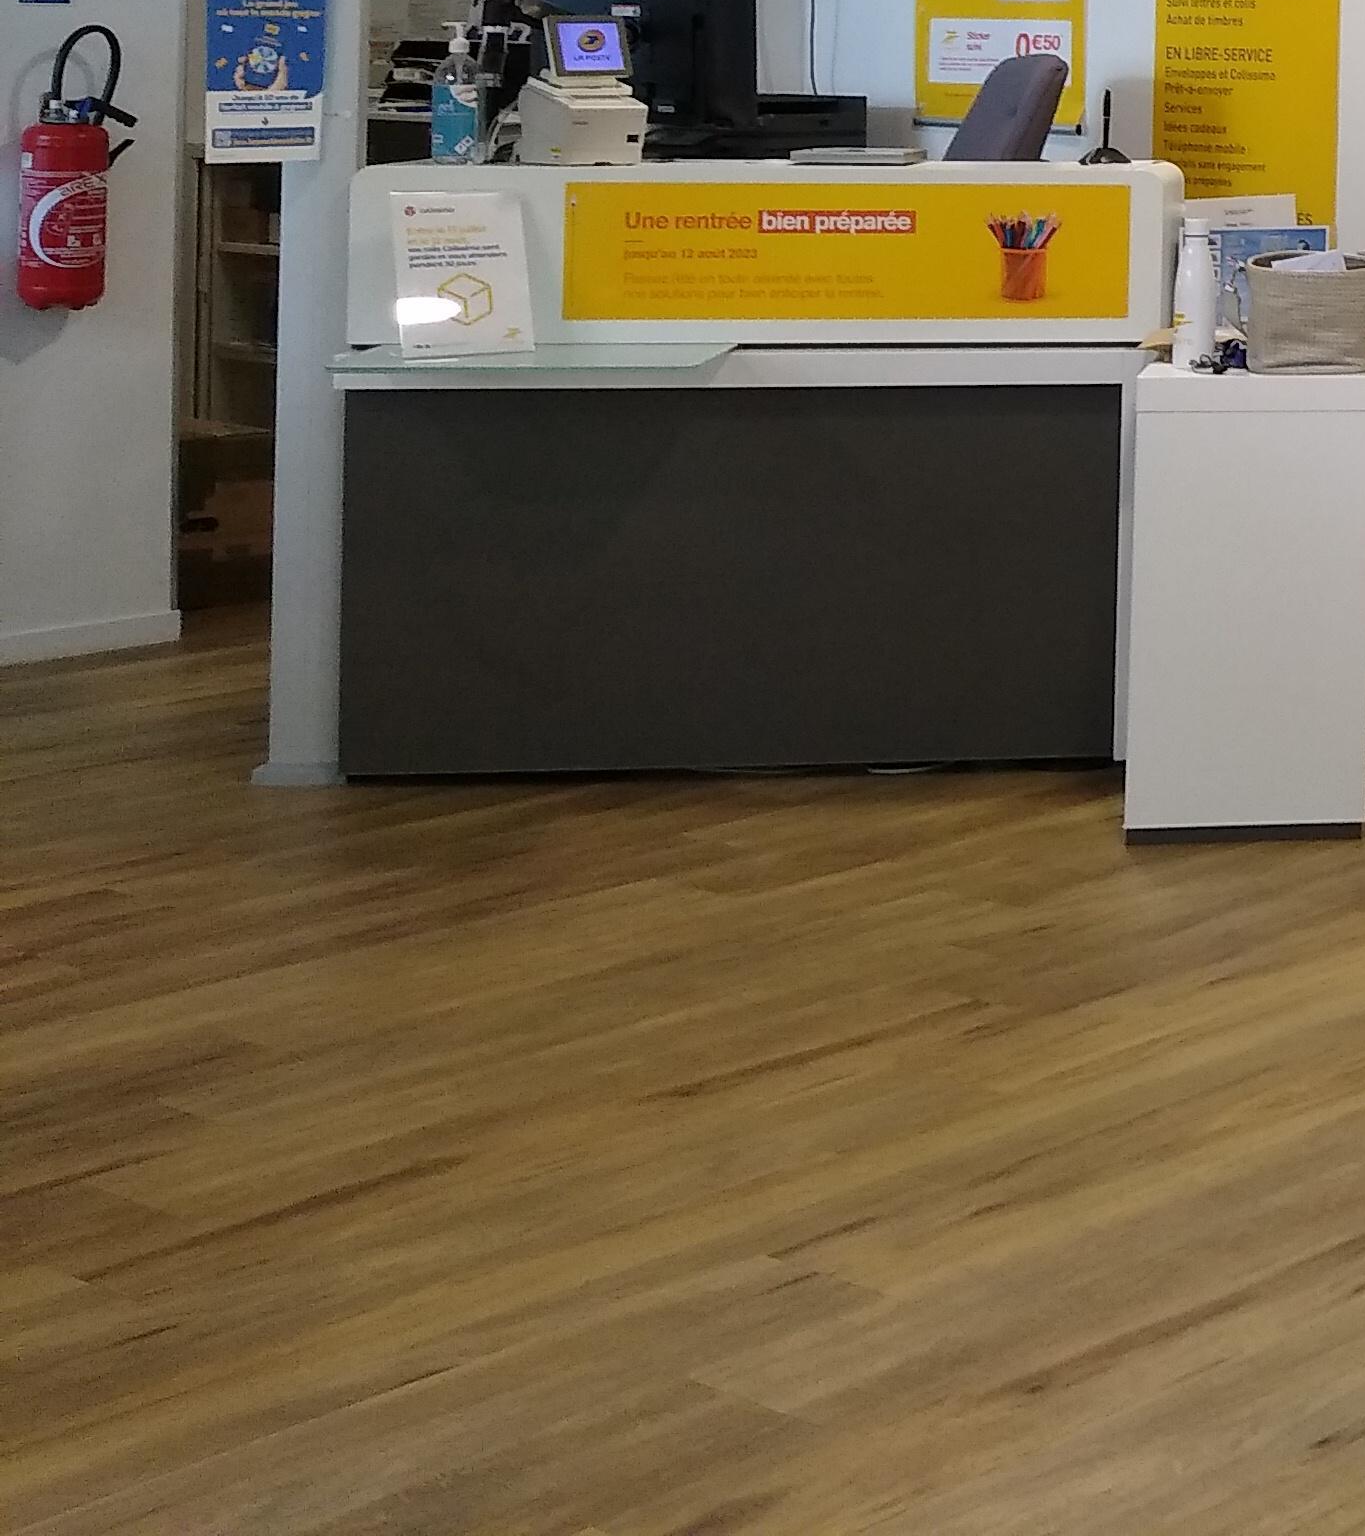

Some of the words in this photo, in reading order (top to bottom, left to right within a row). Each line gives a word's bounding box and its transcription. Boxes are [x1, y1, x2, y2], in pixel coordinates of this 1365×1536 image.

[1166, 14, 1192, 26] Achat
[1207, 14, 1244, 27] timbres
[1166, 47, 1181, 60] EN
[1185, 47, 1273, 63] LIBRE-SERVICE
[625, 211, 669, 230] Une
[675, 210, 752, 230] rentrée
[762, 211, 810, 231] bien
[814, 209, 912, 235] préparée
